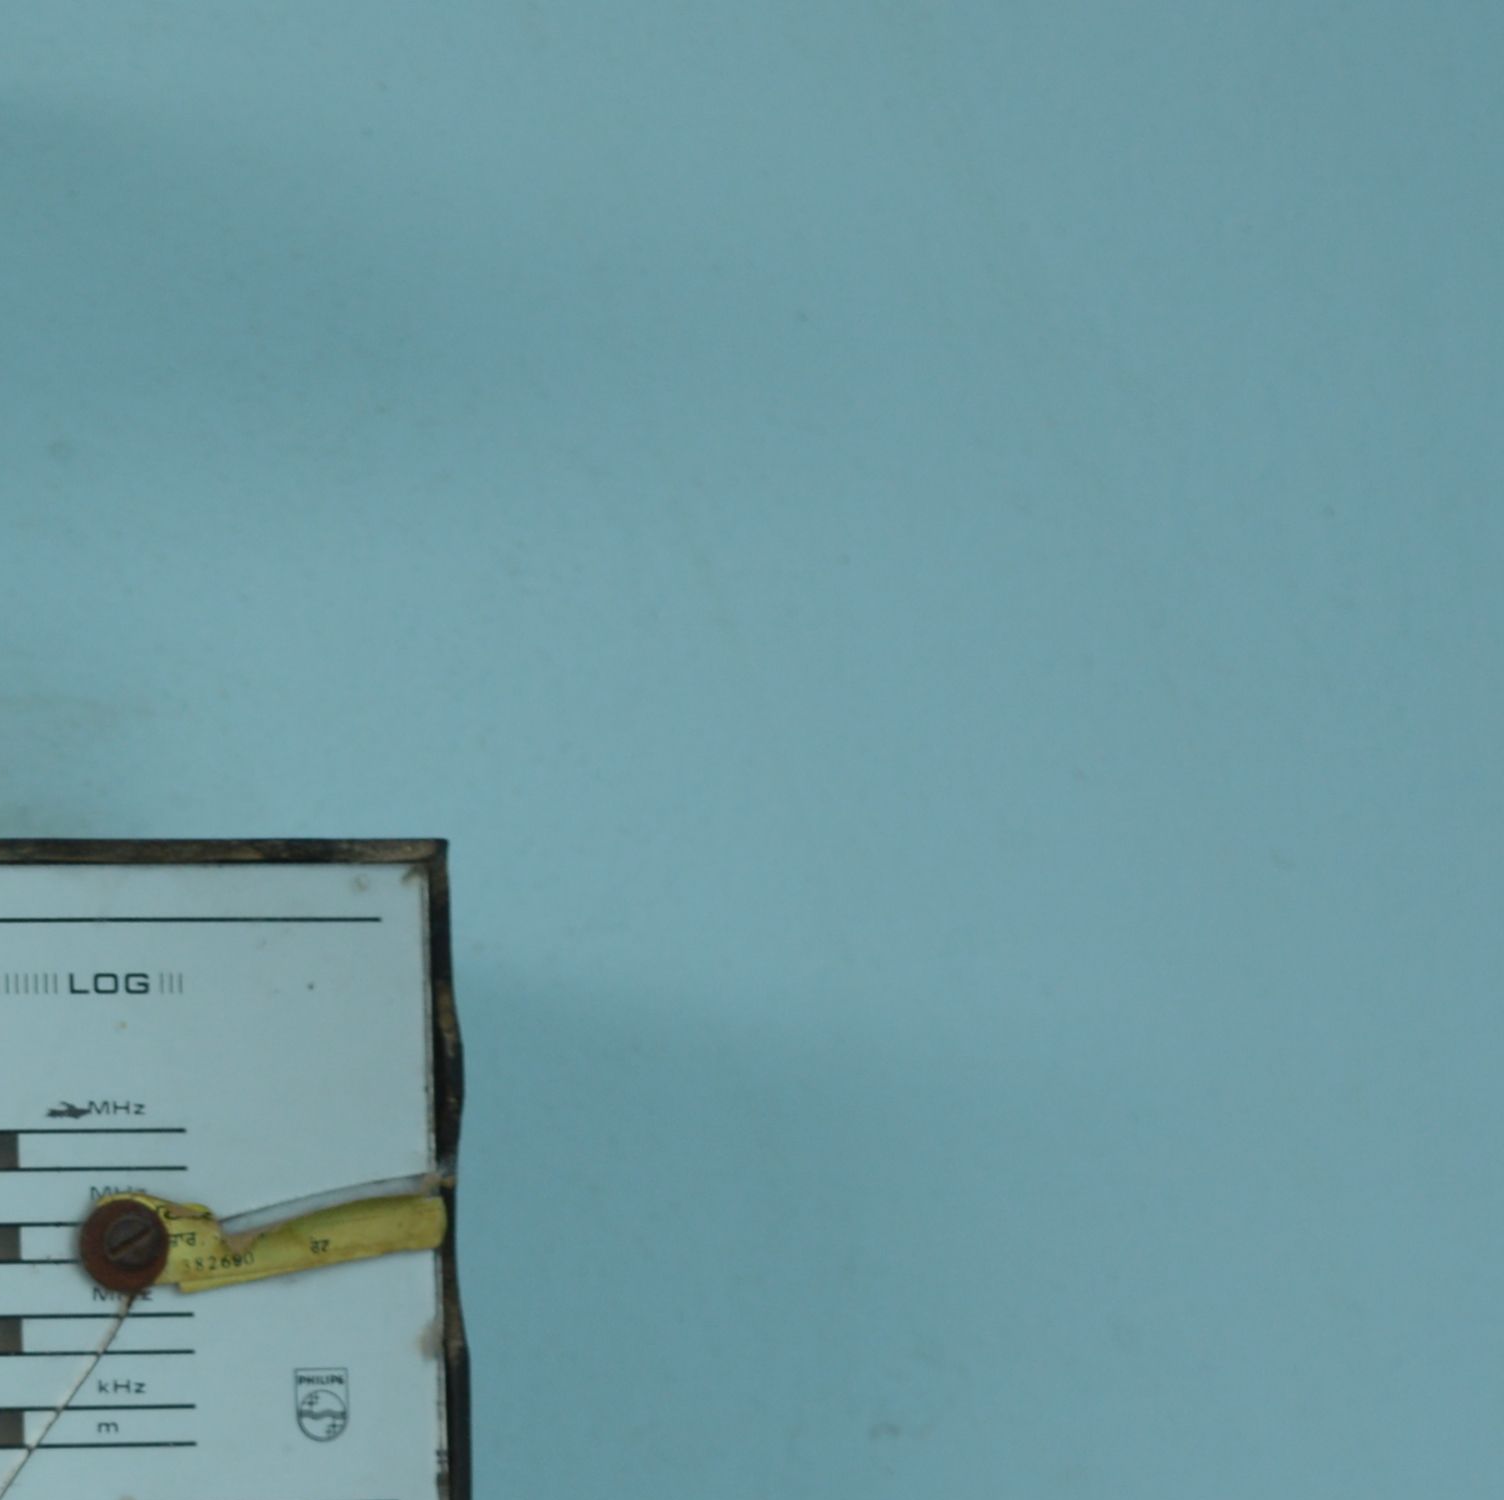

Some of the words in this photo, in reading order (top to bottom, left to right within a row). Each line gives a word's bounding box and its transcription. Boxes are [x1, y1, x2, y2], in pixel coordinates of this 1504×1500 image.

[68, 972, 150, 995] LOG
[87, 1100, 147, 1116] MHz
[98, 1378, 146, 1395] kHz
[296, 1375, 345, 1385] PHILIPS
[98, 1421, 119, 1433] m
